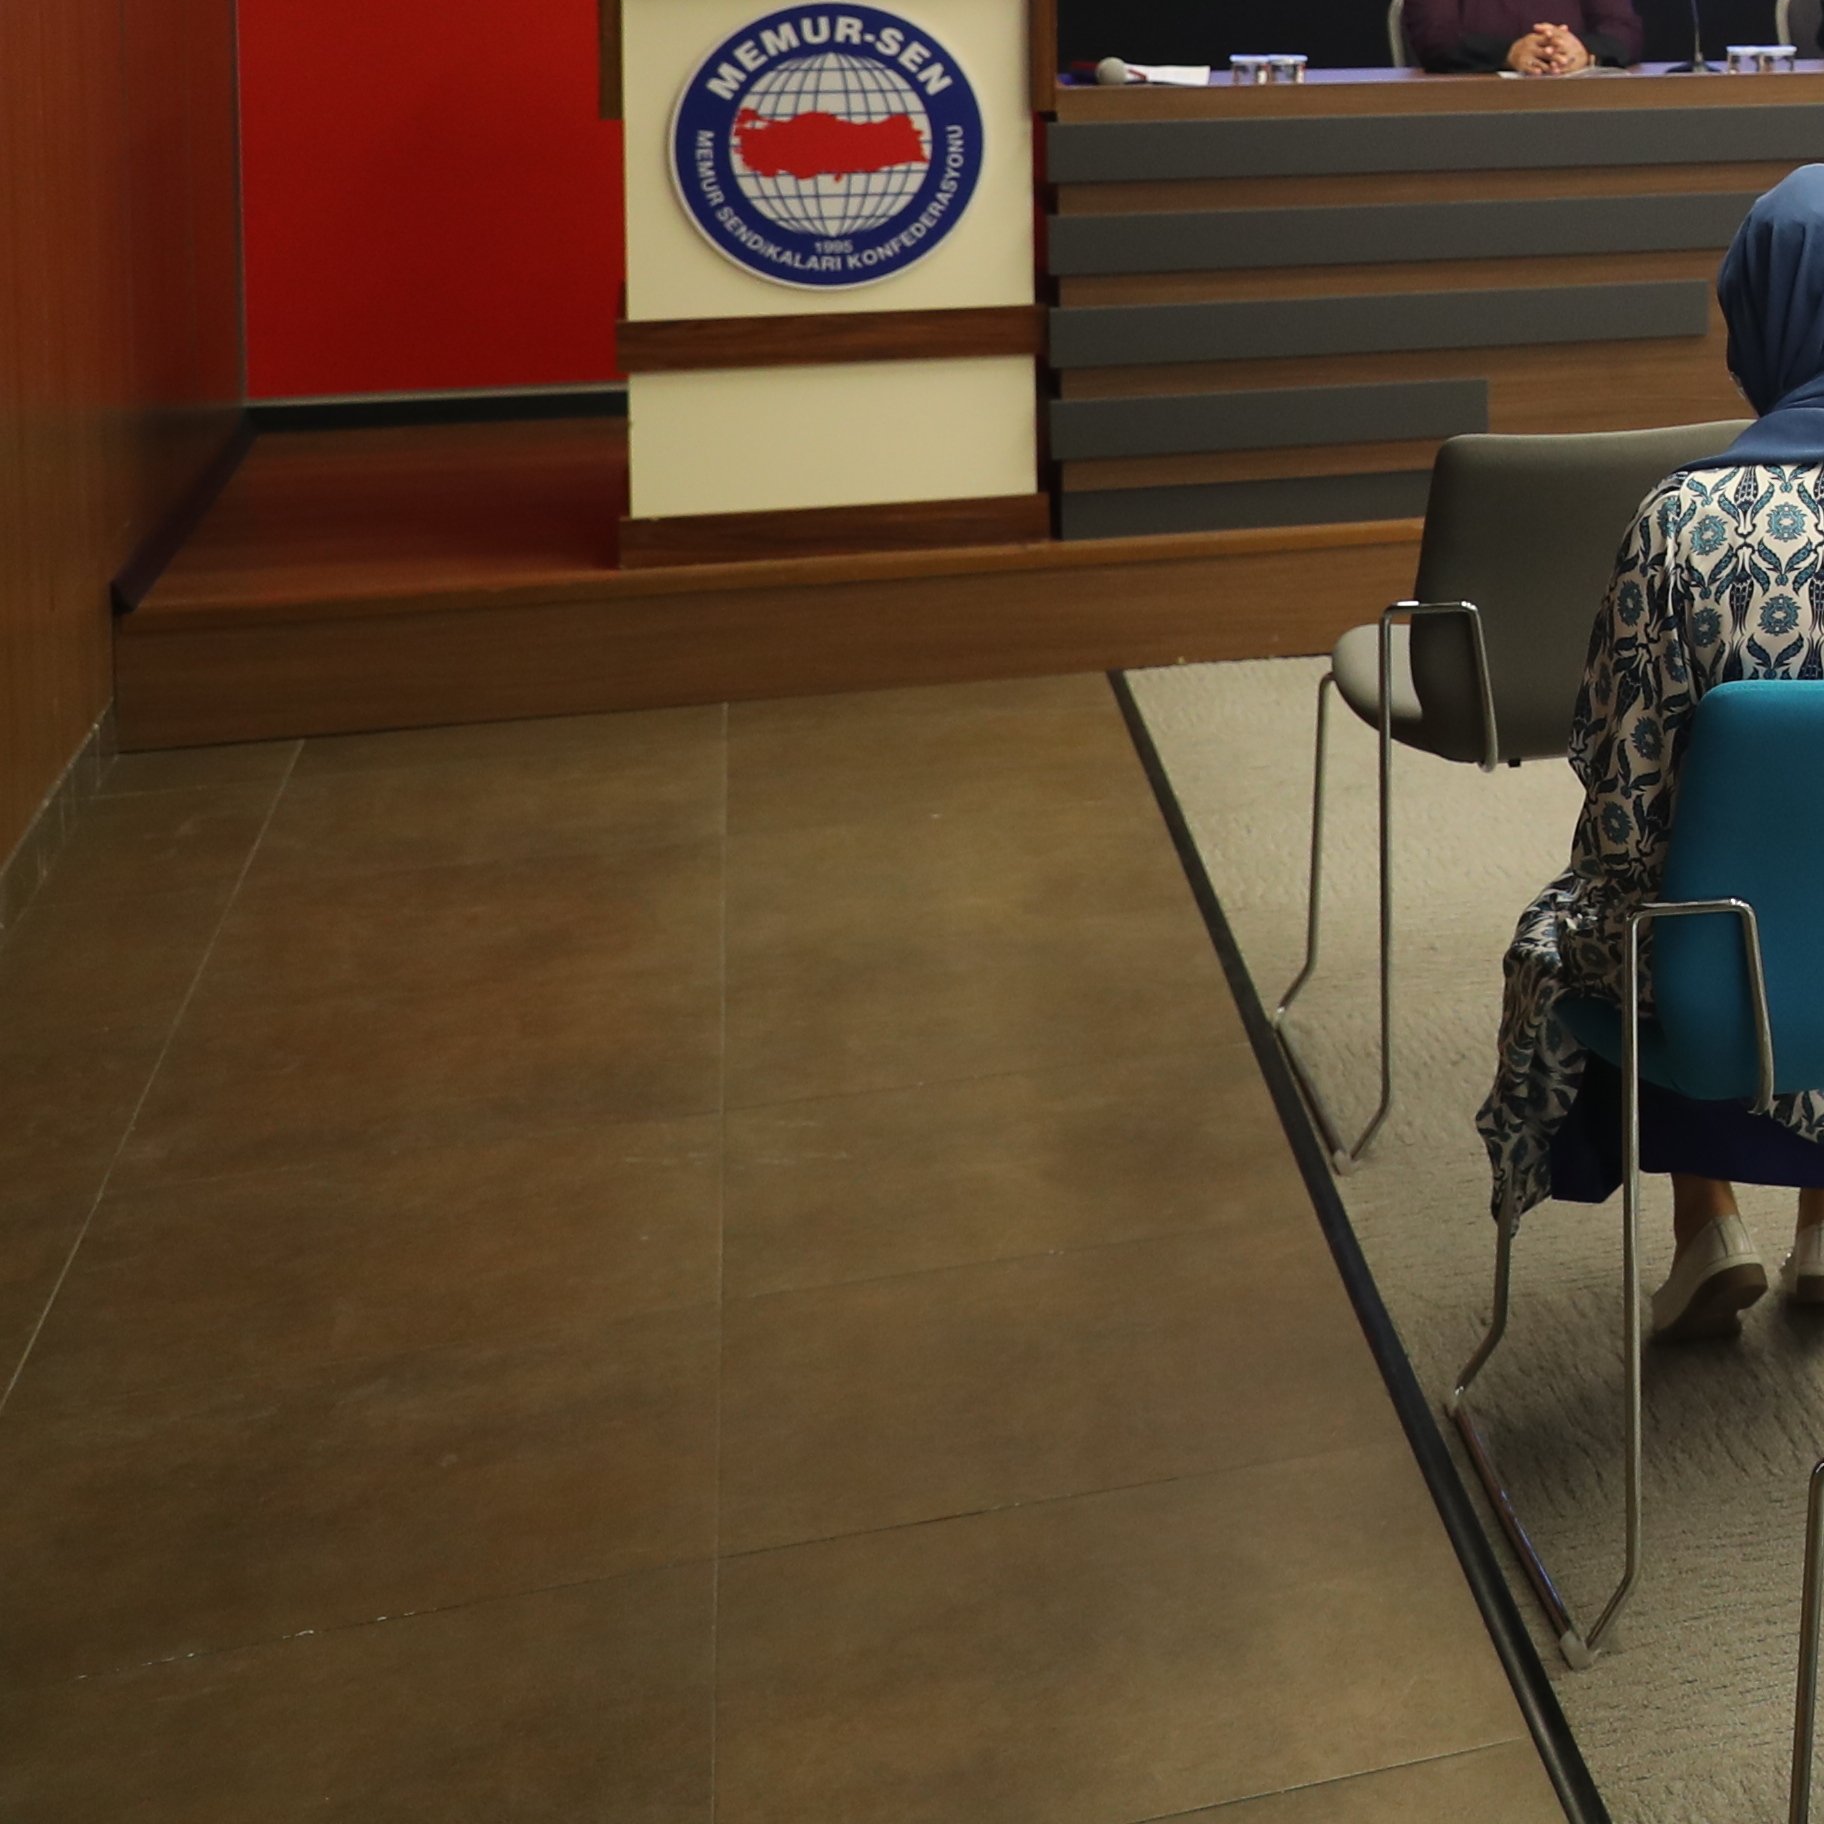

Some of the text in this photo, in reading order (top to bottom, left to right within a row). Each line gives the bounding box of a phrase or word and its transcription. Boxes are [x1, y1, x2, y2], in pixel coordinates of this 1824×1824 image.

[706, 15, 953, 101] MEMUR-SEN
[695, 129, 725, 207] MEMUR
[847, 124, 964, 269] KONFEDERASYONU
[814, 239, 853, 255] 1995
